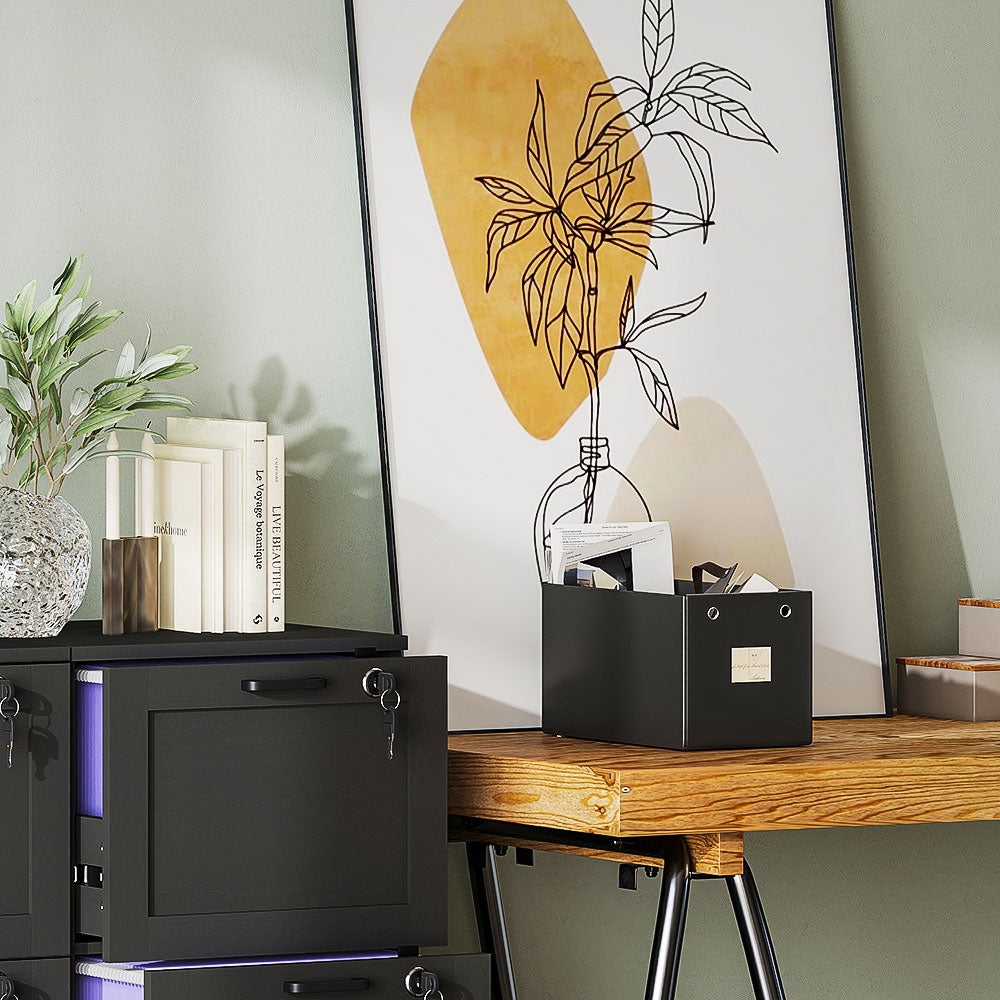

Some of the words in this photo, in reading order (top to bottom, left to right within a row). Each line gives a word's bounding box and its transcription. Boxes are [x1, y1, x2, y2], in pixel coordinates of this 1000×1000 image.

[255, 470, 265, 482] Le
[253, 484, 265, 518] Voyage
[272, 506, 282, 534] LIVE
[253, 521, 265, 570] botanique
[272, 537, 282, 603] BEAUTIFUL
